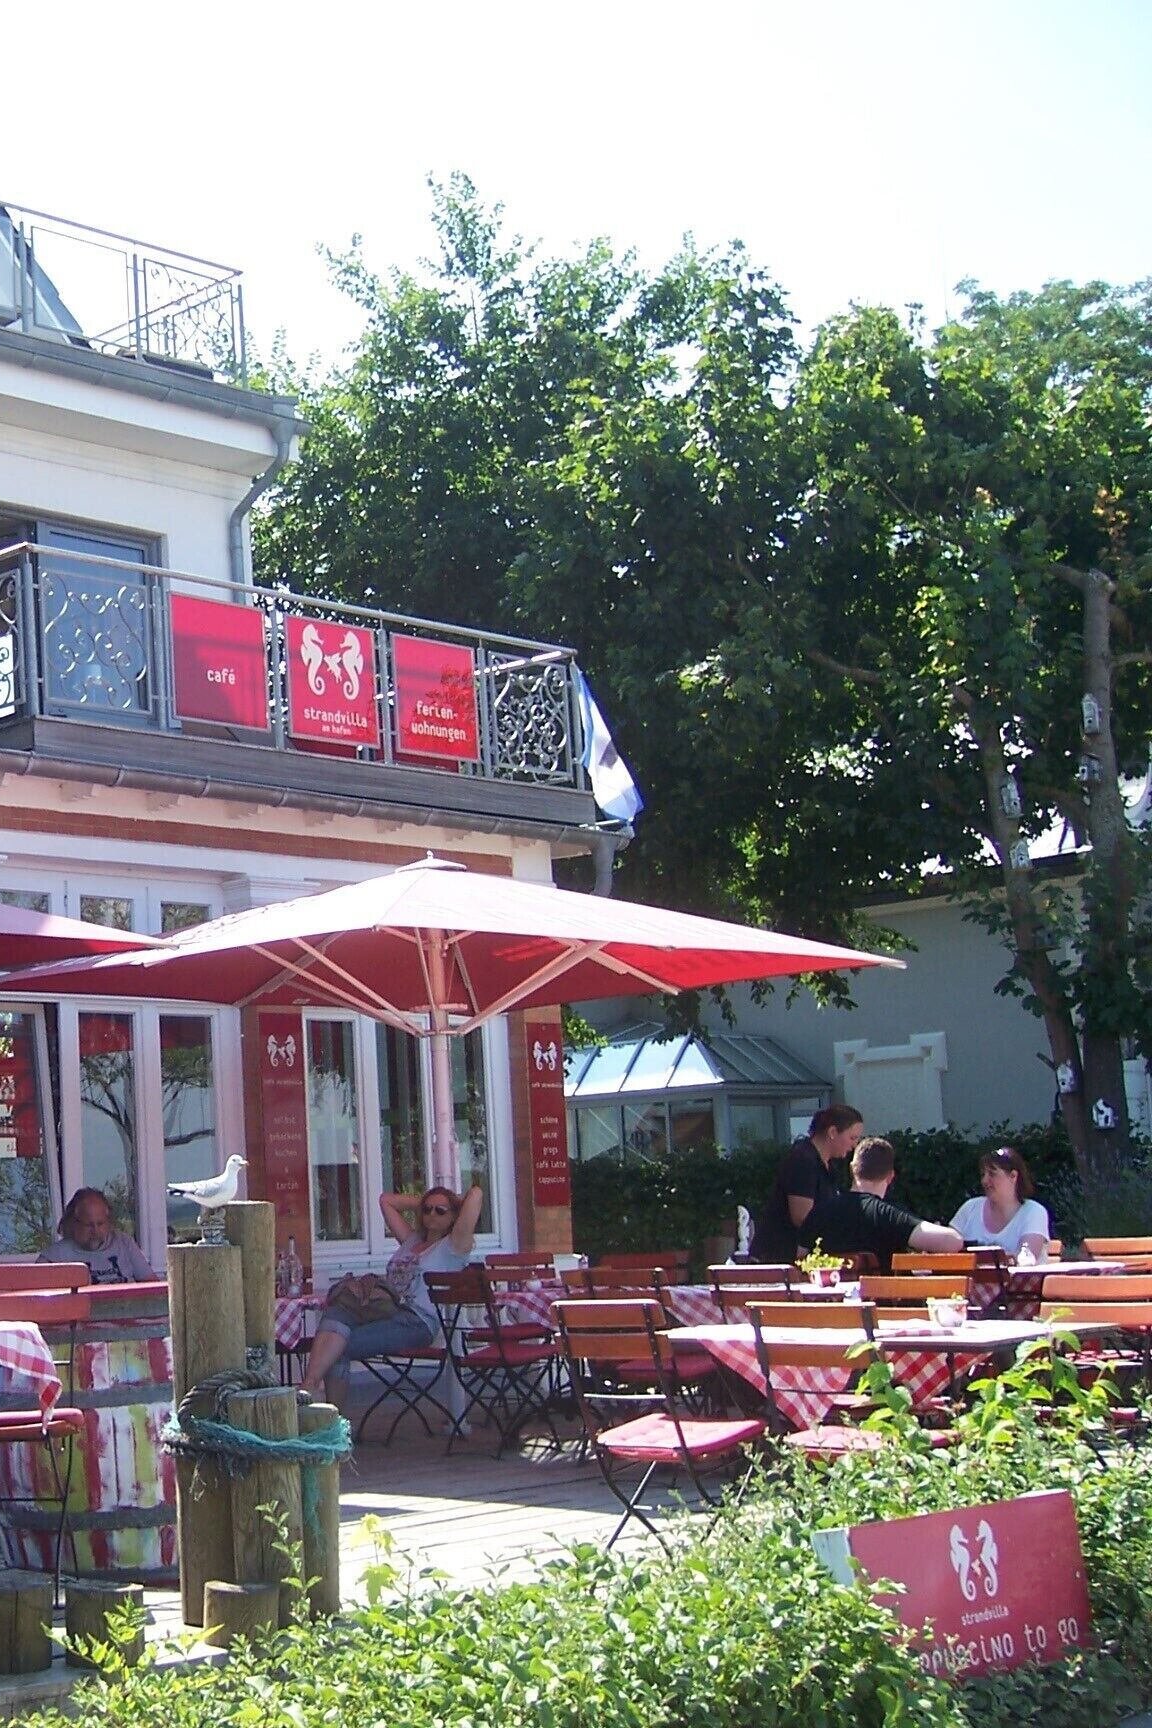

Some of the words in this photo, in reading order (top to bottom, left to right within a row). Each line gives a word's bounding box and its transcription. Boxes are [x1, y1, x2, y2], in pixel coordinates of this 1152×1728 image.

[206, 667, 236, 685] café
[303, 706, 368, 728] strandvilla
[416, 700, 459, 720] ferien-
[411, 721, 467, 743] wohnungen
[960, 1604, 1009, 1627] strandvilla
[1023, 1622, 1048, 1652] to
[1056, 1616, 1080, 1645] go
